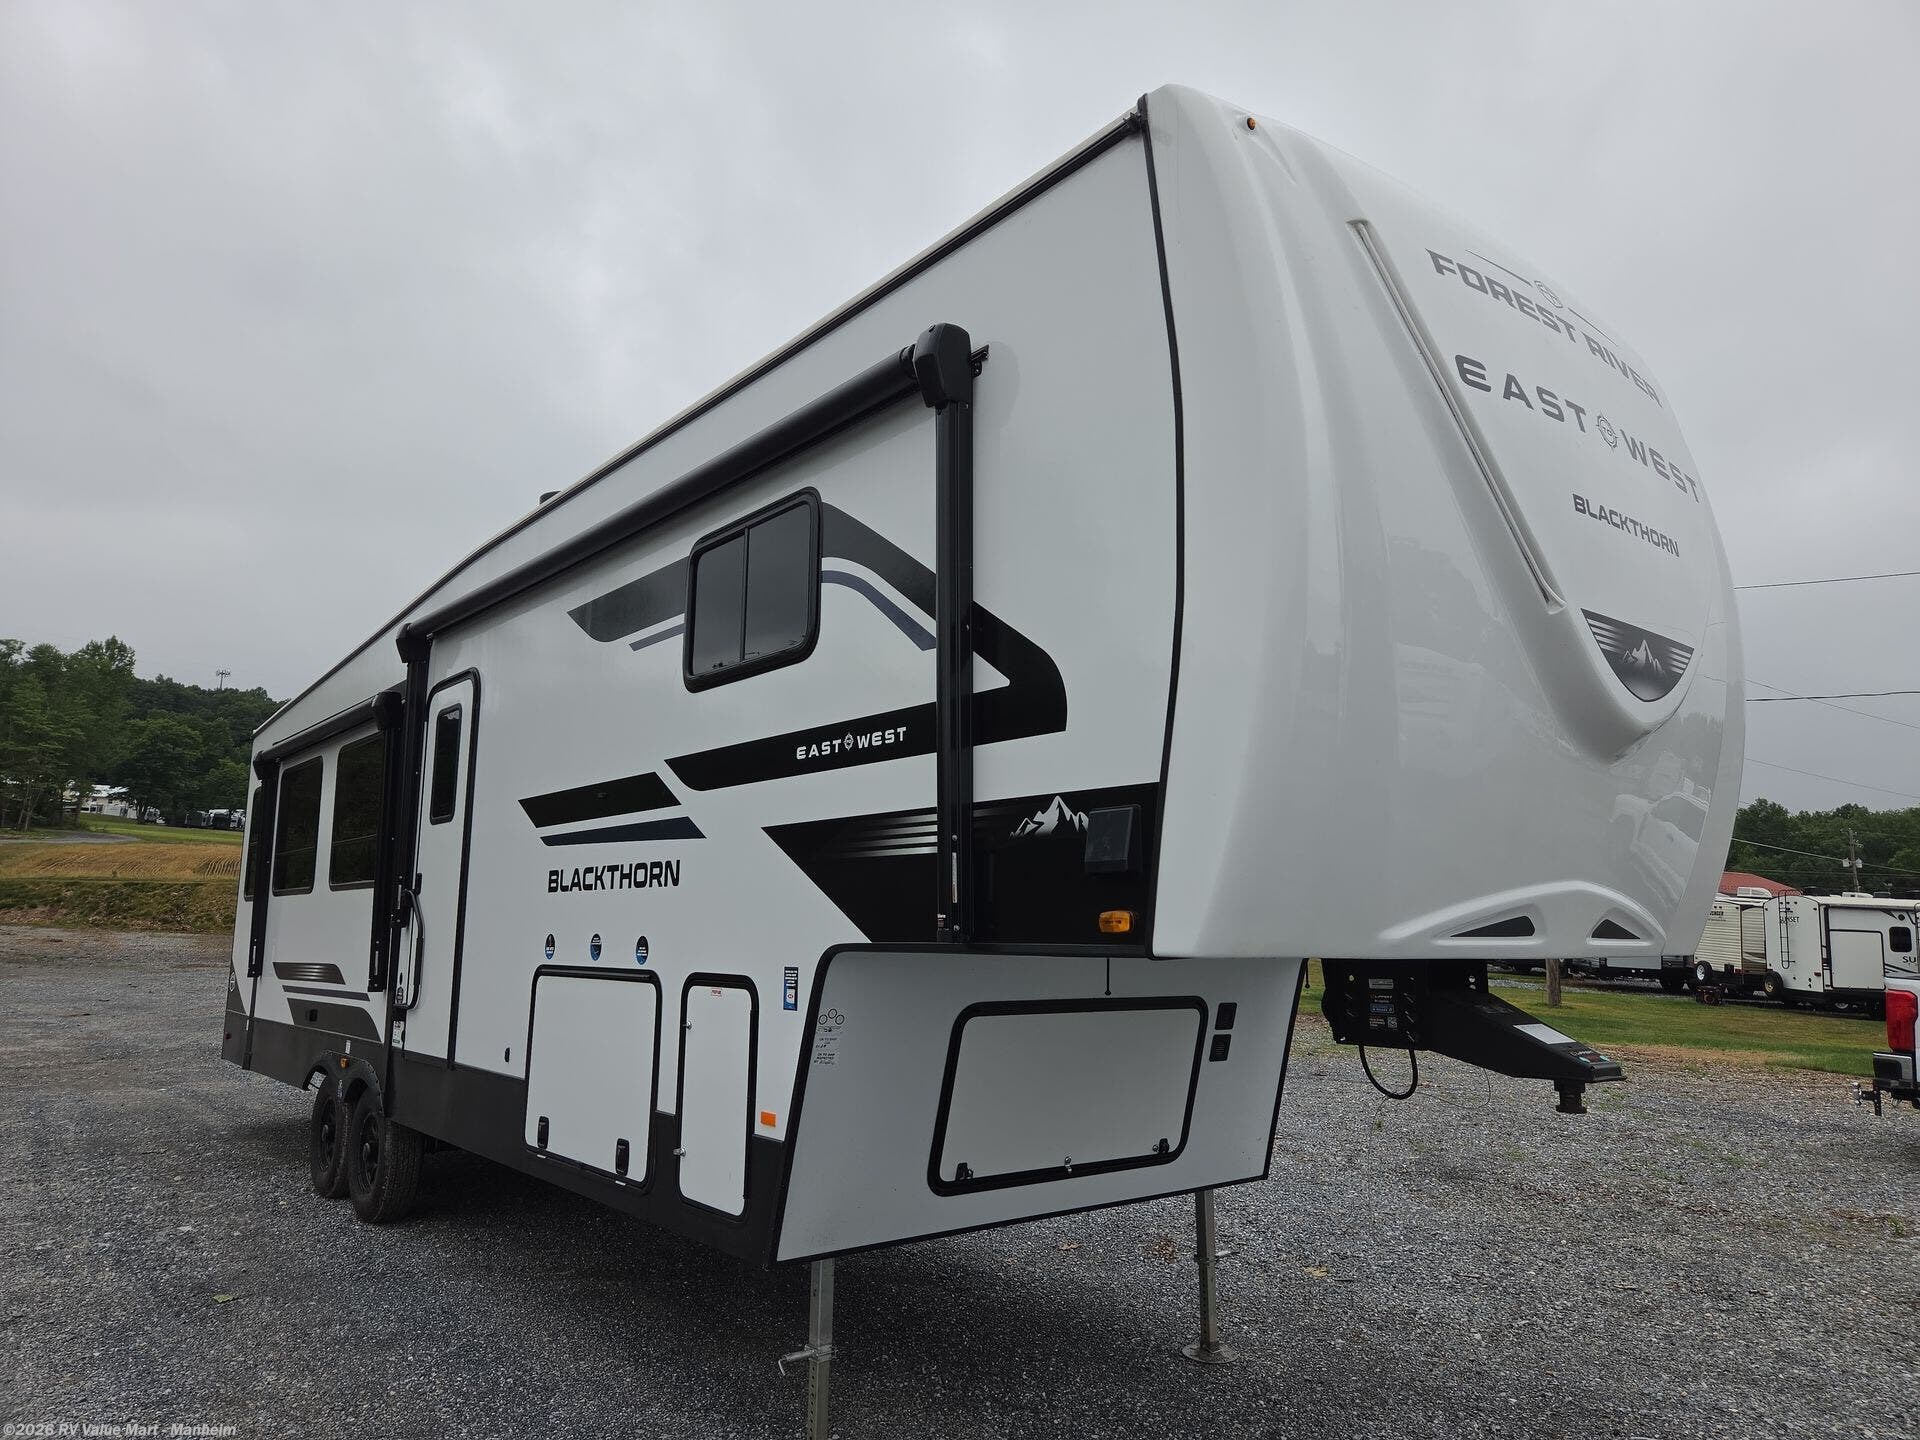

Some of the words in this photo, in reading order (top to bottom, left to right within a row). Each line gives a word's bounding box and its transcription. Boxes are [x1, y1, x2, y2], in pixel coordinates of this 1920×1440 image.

[1425, 248, 1577, 343] FOREST
[1581, 331, 1663, 408] RIVER
[1455, 354, 1587, 433] EAST
[1619, 428, 1700, 504] WEST
[1572, 493, 1680, 558] BLACKTHORN
[796, 738, 842, 760] EAST
[856, 726, 907, 749] WEST
[547, 859, 681, 893] BLACKTHORN
